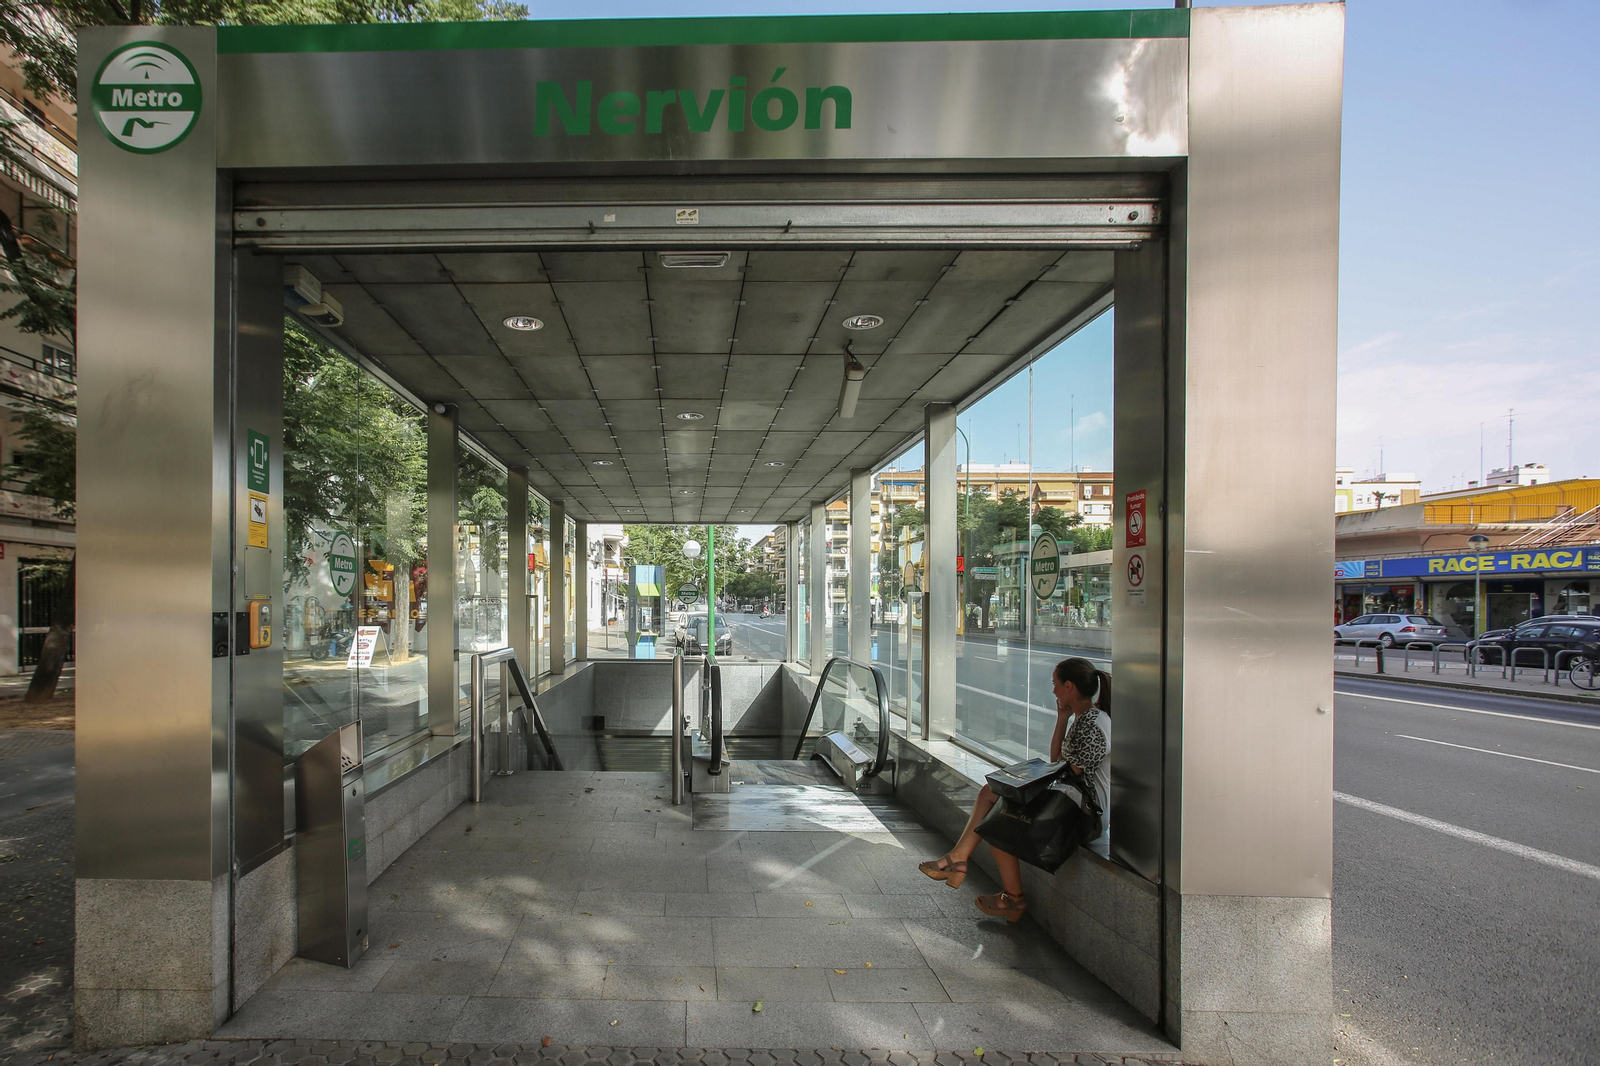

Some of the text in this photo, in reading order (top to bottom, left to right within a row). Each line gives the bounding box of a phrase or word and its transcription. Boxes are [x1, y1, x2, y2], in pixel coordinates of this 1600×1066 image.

[111, 88, 183, 107] Metro
[533, 67, 853, 137] Nervión
[1126, 493, 1146, 502] Prohibido
[334, 557, 353, 571] Metro
[1034, 561, 1055, 573] Metro
[1428, 556, 1496, 573] RACE
